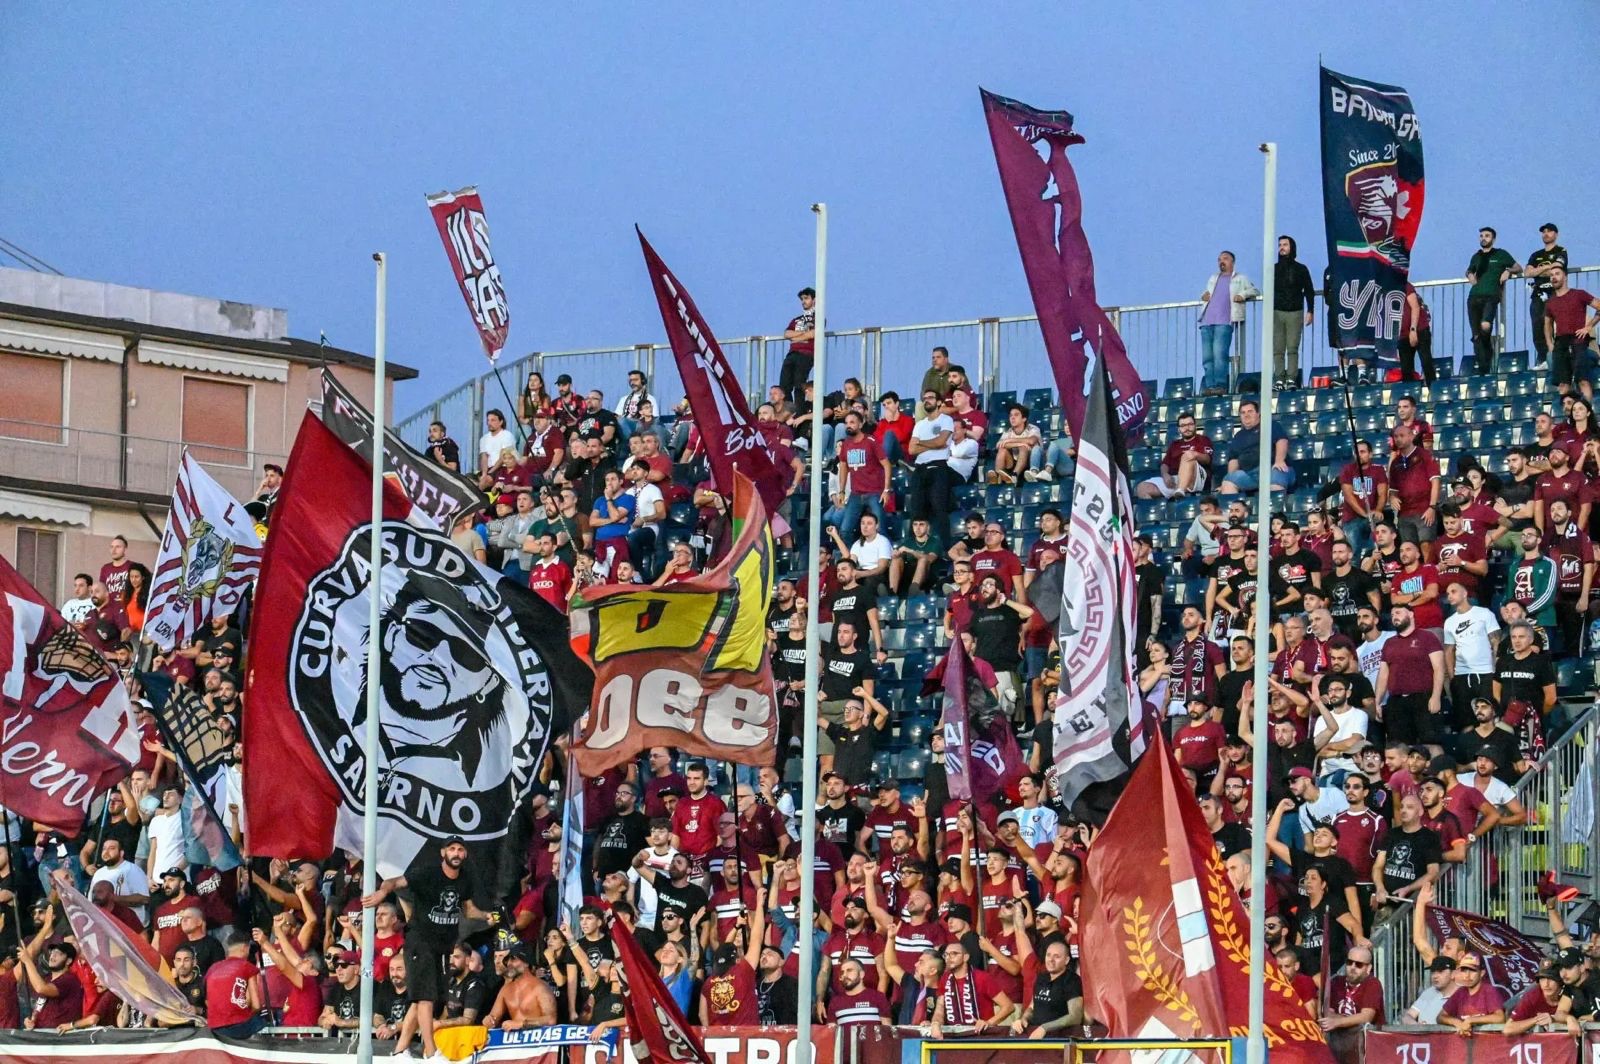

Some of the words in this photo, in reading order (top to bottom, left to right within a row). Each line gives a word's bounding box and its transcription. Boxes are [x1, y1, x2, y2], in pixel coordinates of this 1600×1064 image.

[1349, 149, 1379, 167] Since
[381, 531, 467, 578] SUD
[299, 548, 373, 679] CURVA
[503, 1026, 562, 1045] ULTRAS
